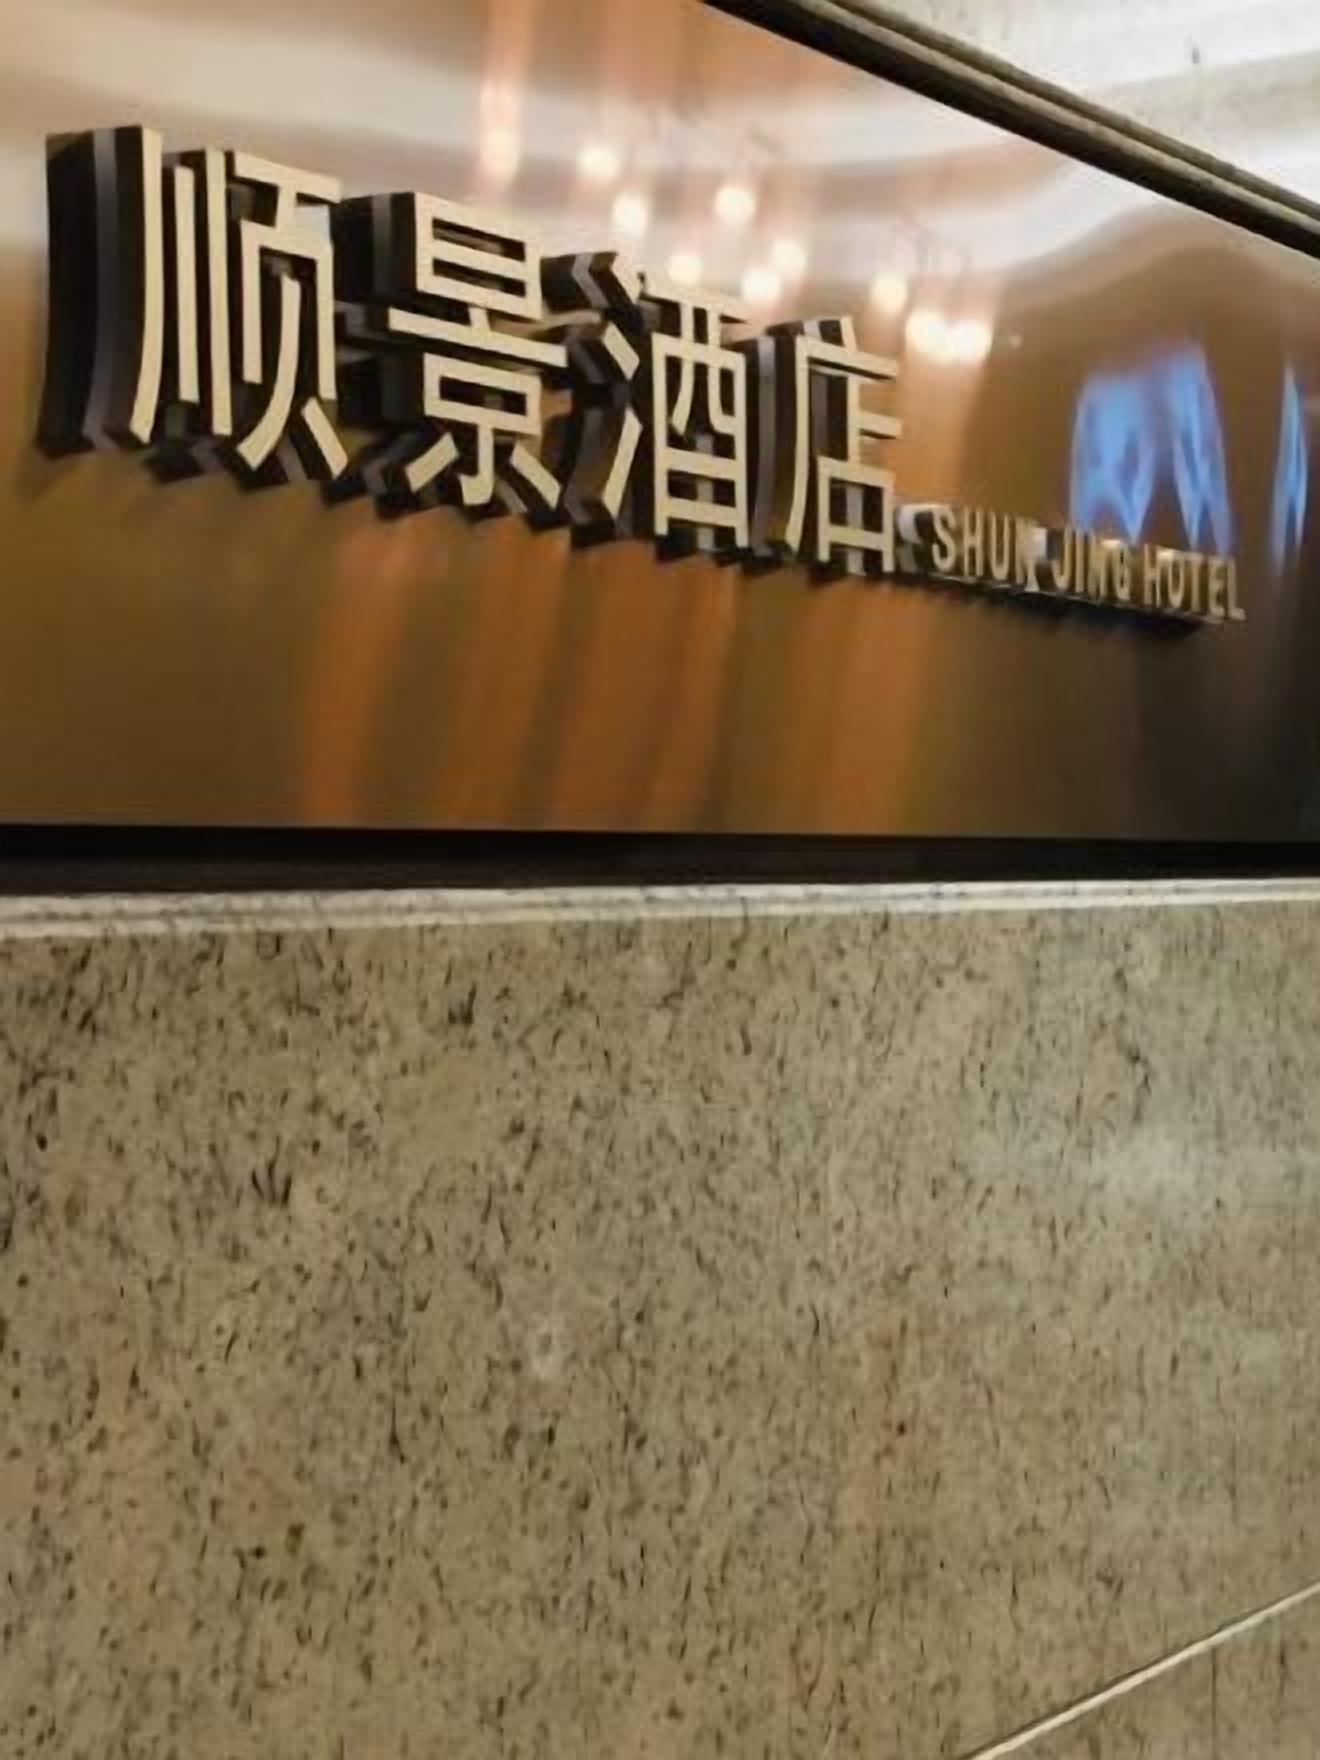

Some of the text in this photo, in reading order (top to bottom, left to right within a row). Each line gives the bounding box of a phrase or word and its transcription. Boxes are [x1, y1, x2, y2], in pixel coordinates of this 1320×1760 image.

[130, 126, 904, 575] 顺景酒店
[931, 504, 1247, 621] SHUN JING HOTEL
